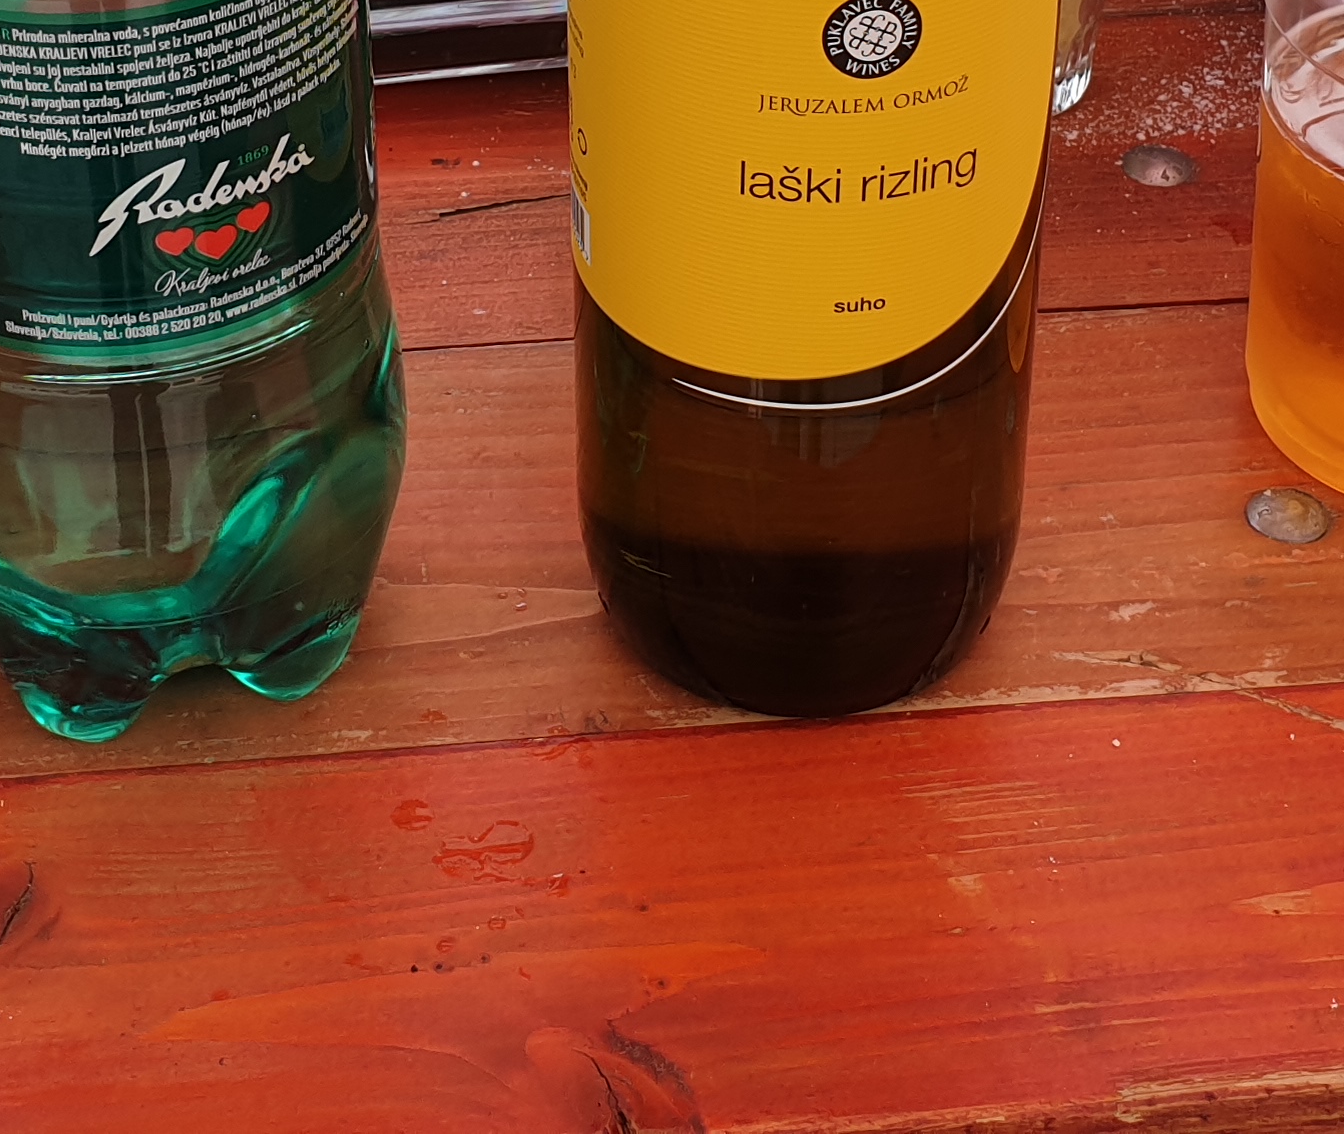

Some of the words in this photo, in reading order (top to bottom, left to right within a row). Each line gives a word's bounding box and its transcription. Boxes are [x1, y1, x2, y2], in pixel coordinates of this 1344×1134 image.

[844, 53, 901, 77] WINES
[758, 94, 886, 116] JERUZALEM
[893, 74, 969, 109] ORMOŽ
[237, 144, 270, 166] 1869
[740, 160, 842, 205] laški
[861, 147, 978, 203] rizling
[89, 132, 316, 257] Radenska
[154, 266, 230, 297] Kraljevi
[232, 248, 272, 278] vrelec
[833, 294, 887, 314] suho
